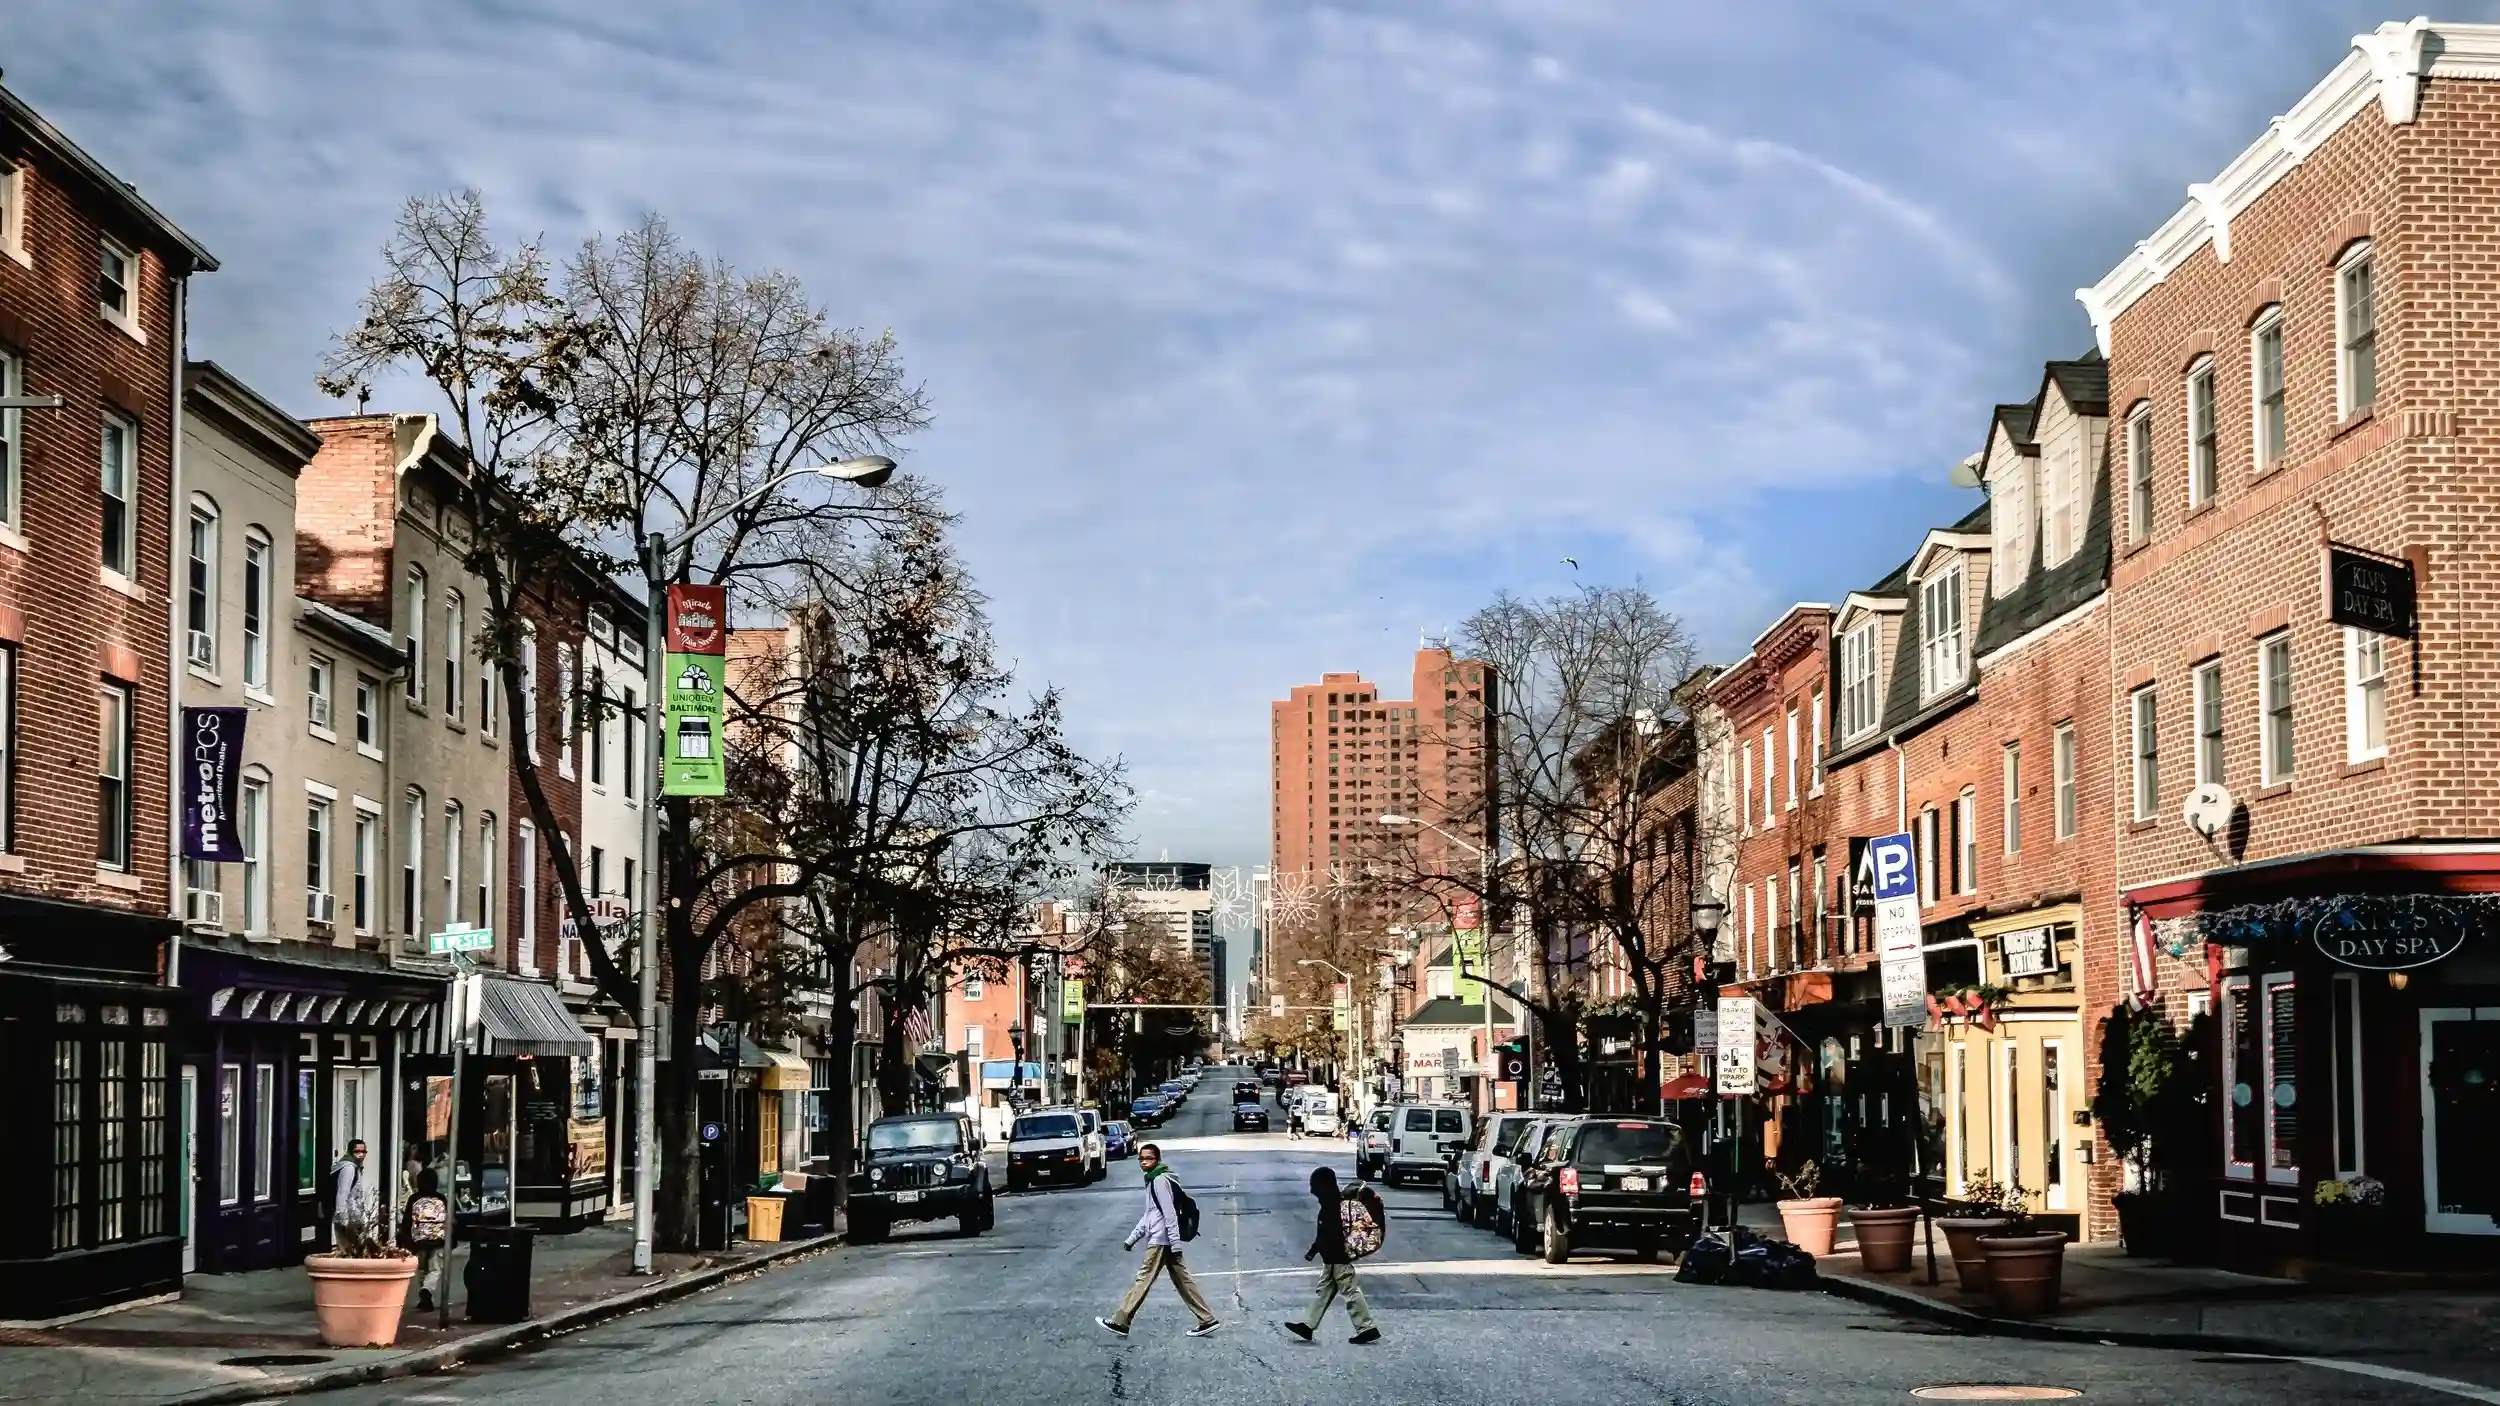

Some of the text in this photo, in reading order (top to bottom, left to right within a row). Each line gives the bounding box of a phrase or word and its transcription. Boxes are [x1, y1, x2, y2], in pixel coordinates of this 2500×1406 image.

[682, 598, 712, 611] Miracle
[2343, 590, 2396, 622] DAY SPA
[681, 632, 697, 648] Main
[672, 693, 714, 703] UNIQUELY
[670, 704, 717, 714] BALTIMORE
[216, 741, 227, 773] Dealer
[195, 713, 220, 852] metroPCS
[1875, 844, 1909, 891] P
[1889, 906, 1905, 920] NO
[2339, 937, 2441, 957] DAY SPA
[1413, 1059, 1469, 1068] MART
